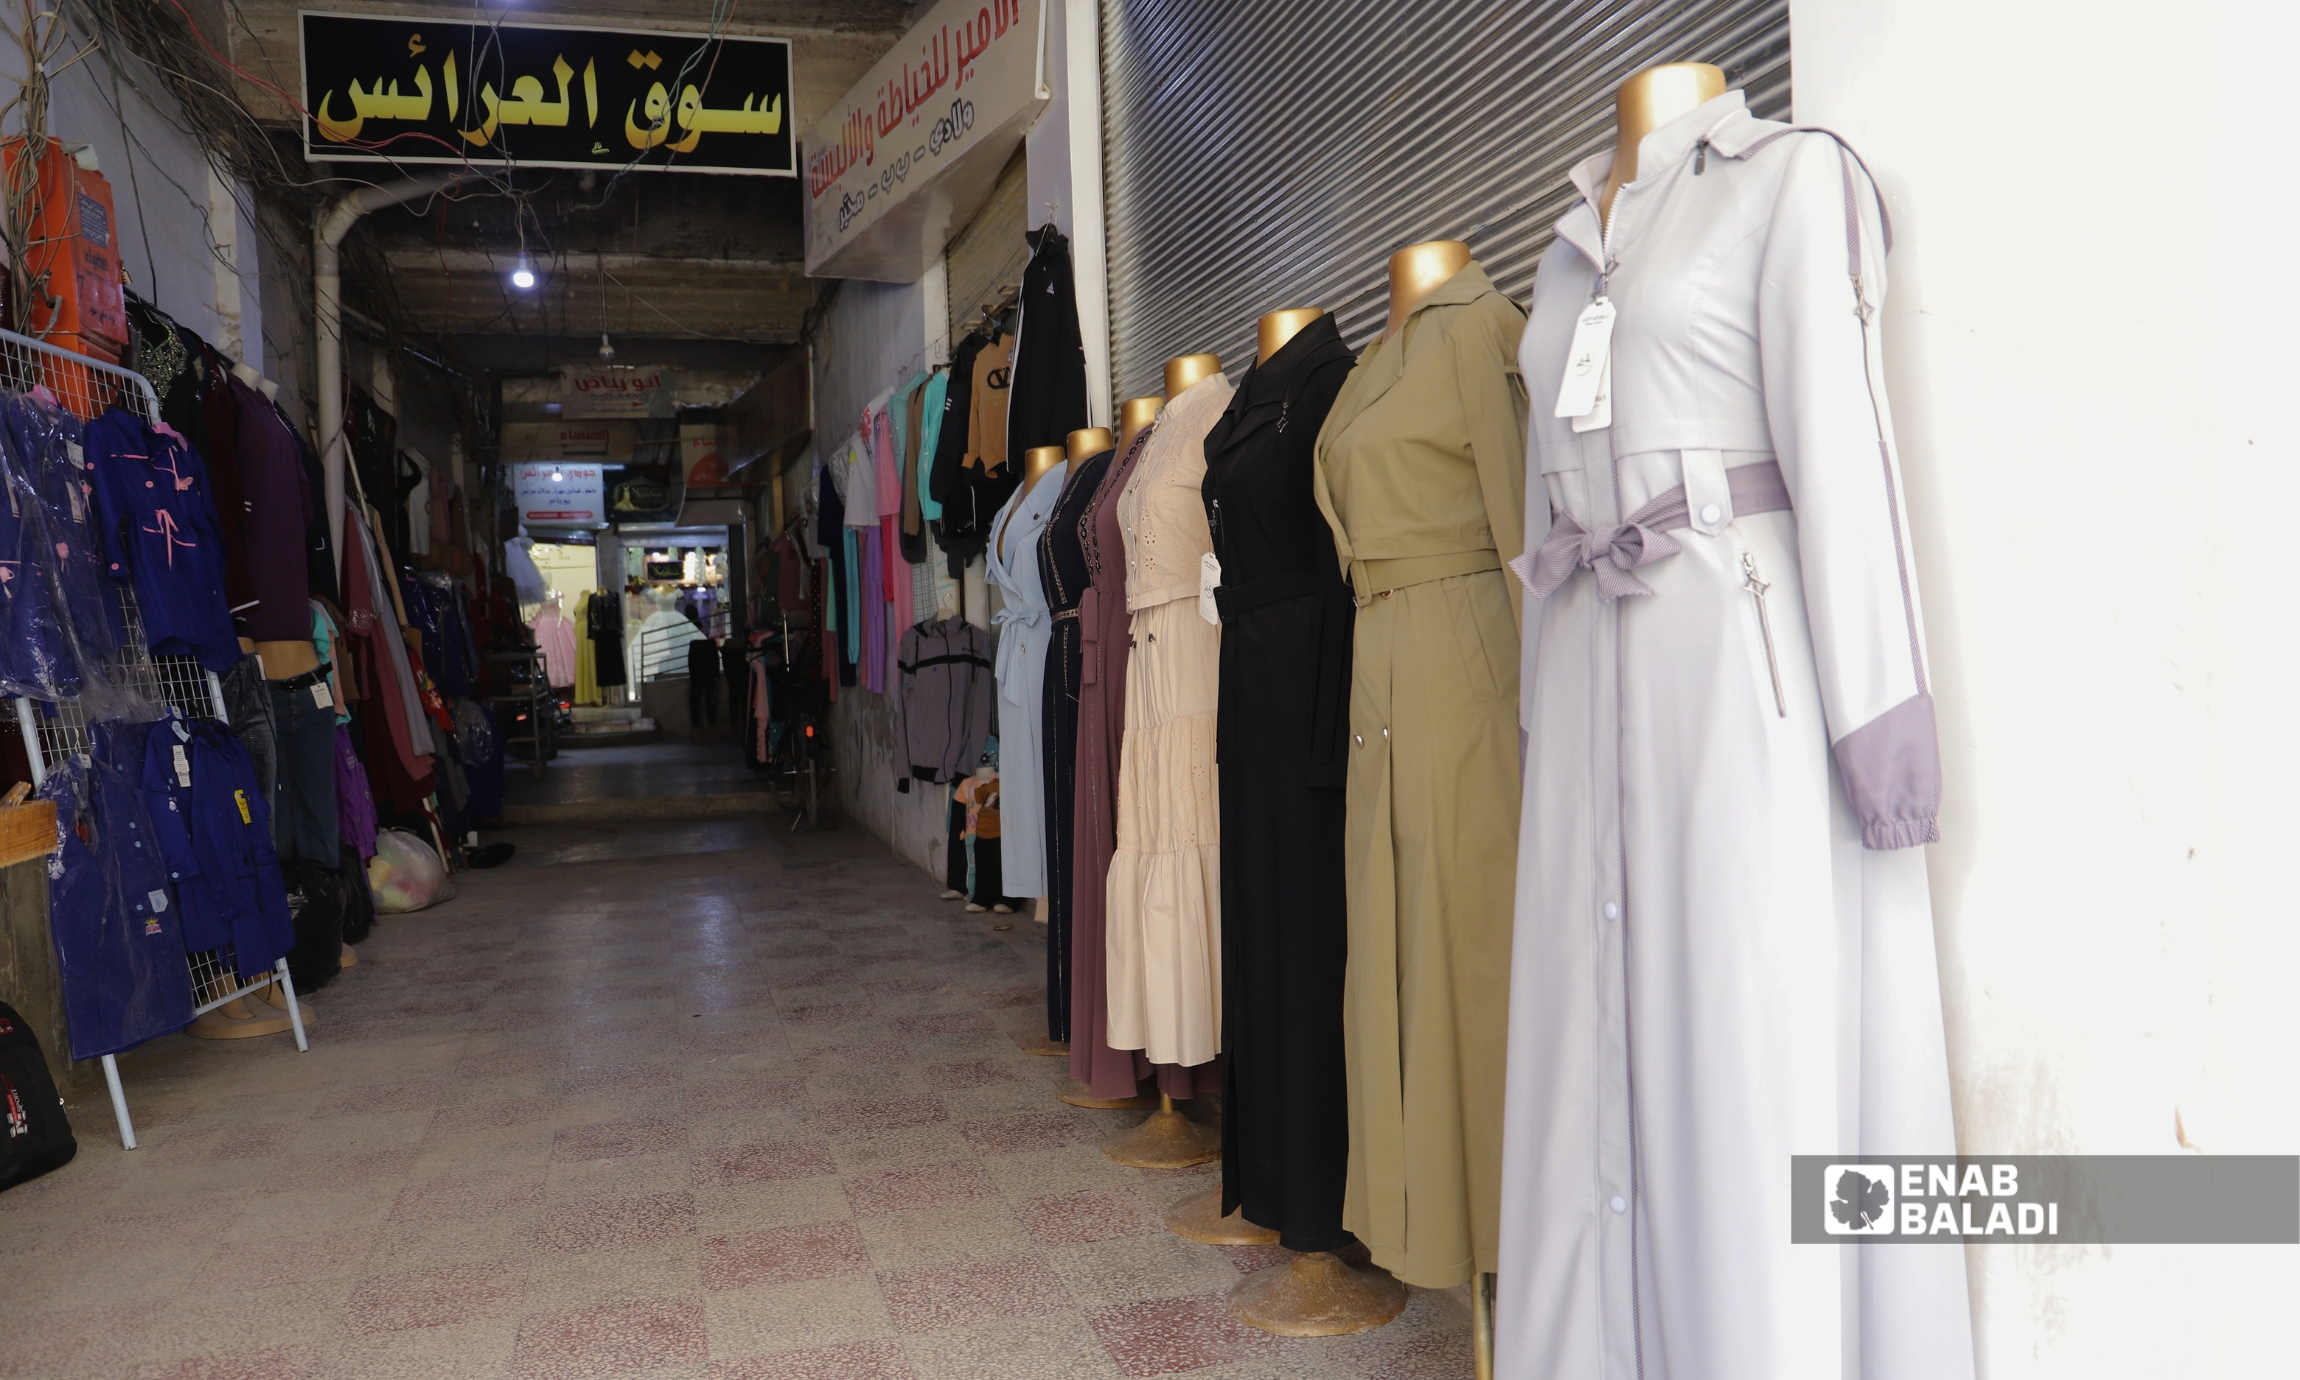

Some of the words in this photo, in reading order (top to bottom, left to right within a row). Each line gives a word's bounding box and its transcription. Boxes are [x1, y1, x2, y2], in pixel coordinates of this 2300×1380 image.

[317, 33, 599, 148] العرائس
[624, 48, 782, 154] سوق
[877, 24, 950, 139] للخياطة
[811, 104, 875, 199] والألبسة
[929, 97, 975, 157] ولادي
[574, 374, 628, 392] رياض
[631, 370, 662, 393] أبو
[10, 1088, 24, 1113] SPORT
